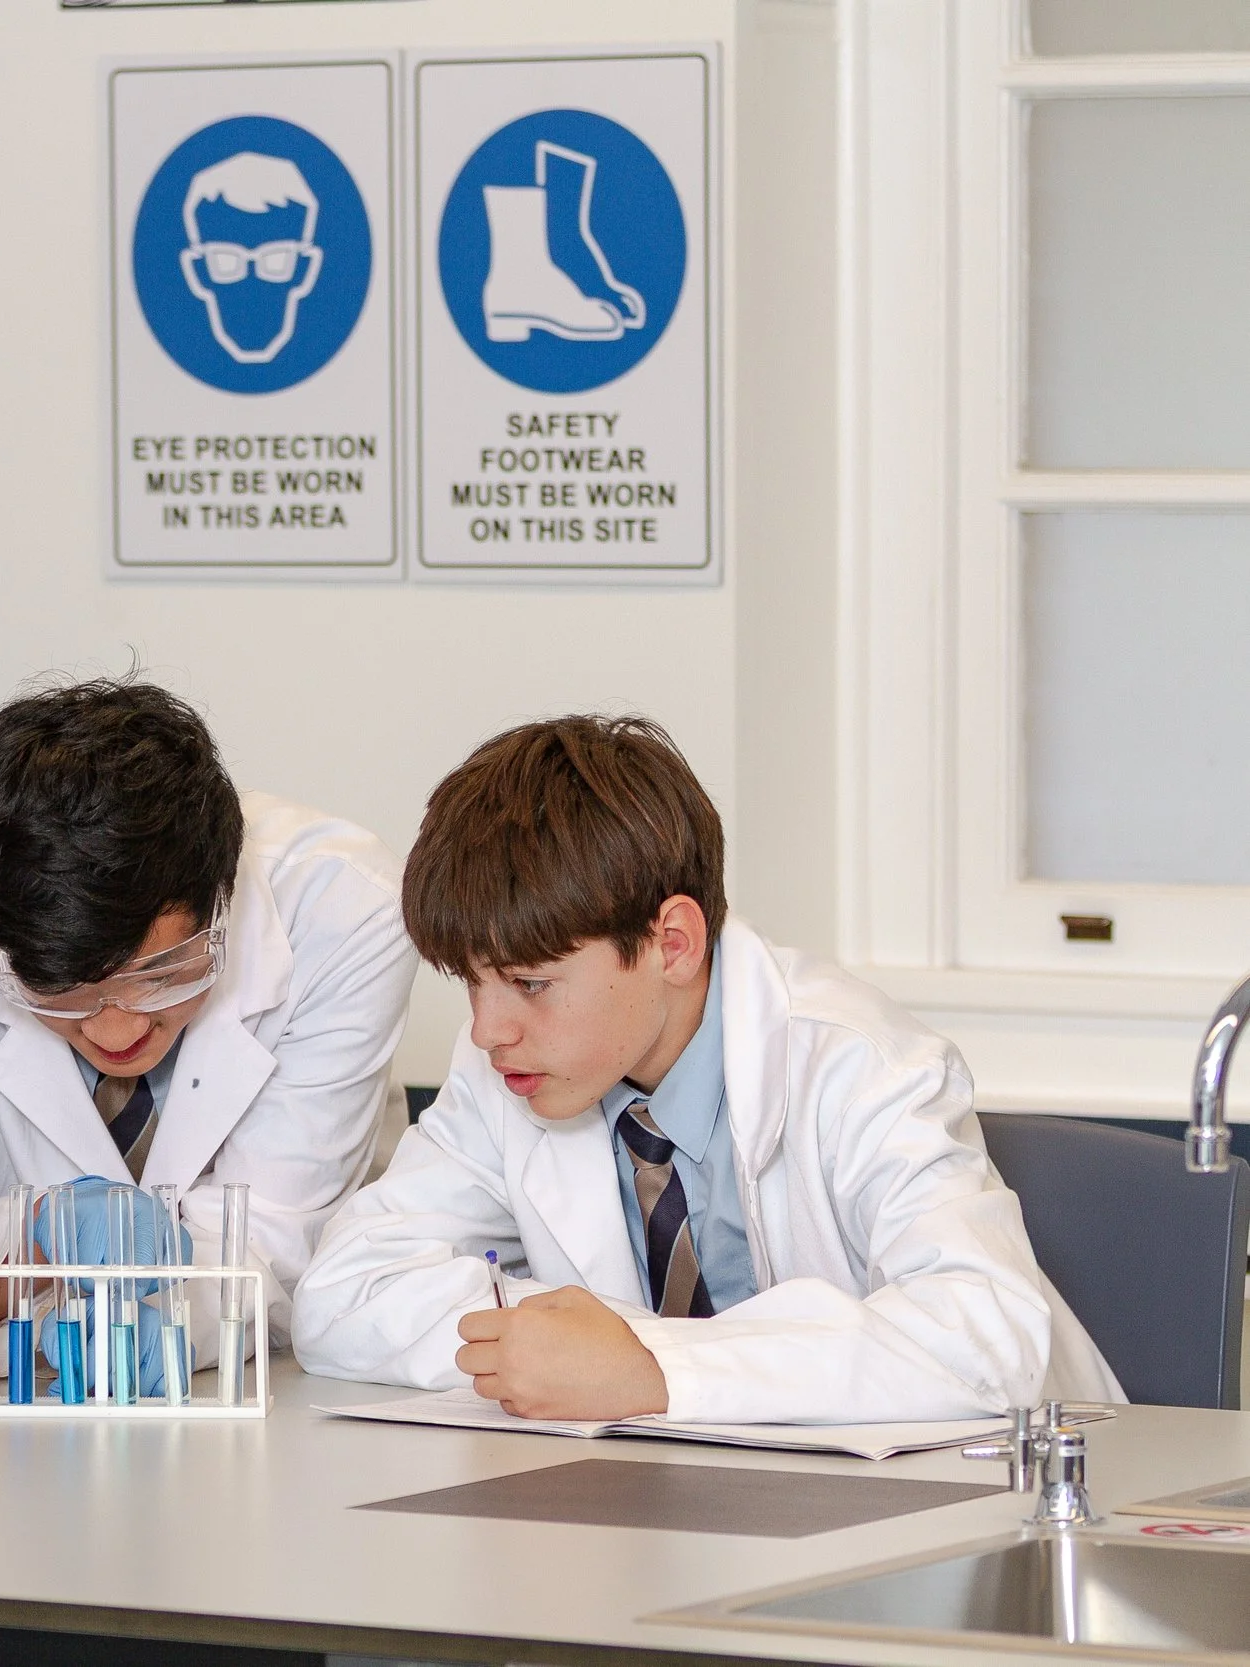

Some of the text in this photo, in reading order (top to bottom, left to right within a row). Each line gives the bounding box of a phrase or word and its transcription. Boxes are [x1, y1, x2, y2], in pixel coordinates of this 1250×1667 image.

[507, 412, 620, 438] SAFETY
[132, 434, 377, 461] EYE PROTECTION
[480, 447, 647, 473] FOOTWEAR
[145, 469, 363, 495] MUST BE WORN
[451, 482, 677, 508] MUST BE WORN
[163, 504, 347, 529] IN THIS AREA
[469, 517, 658, 543] ON THIS SITE
